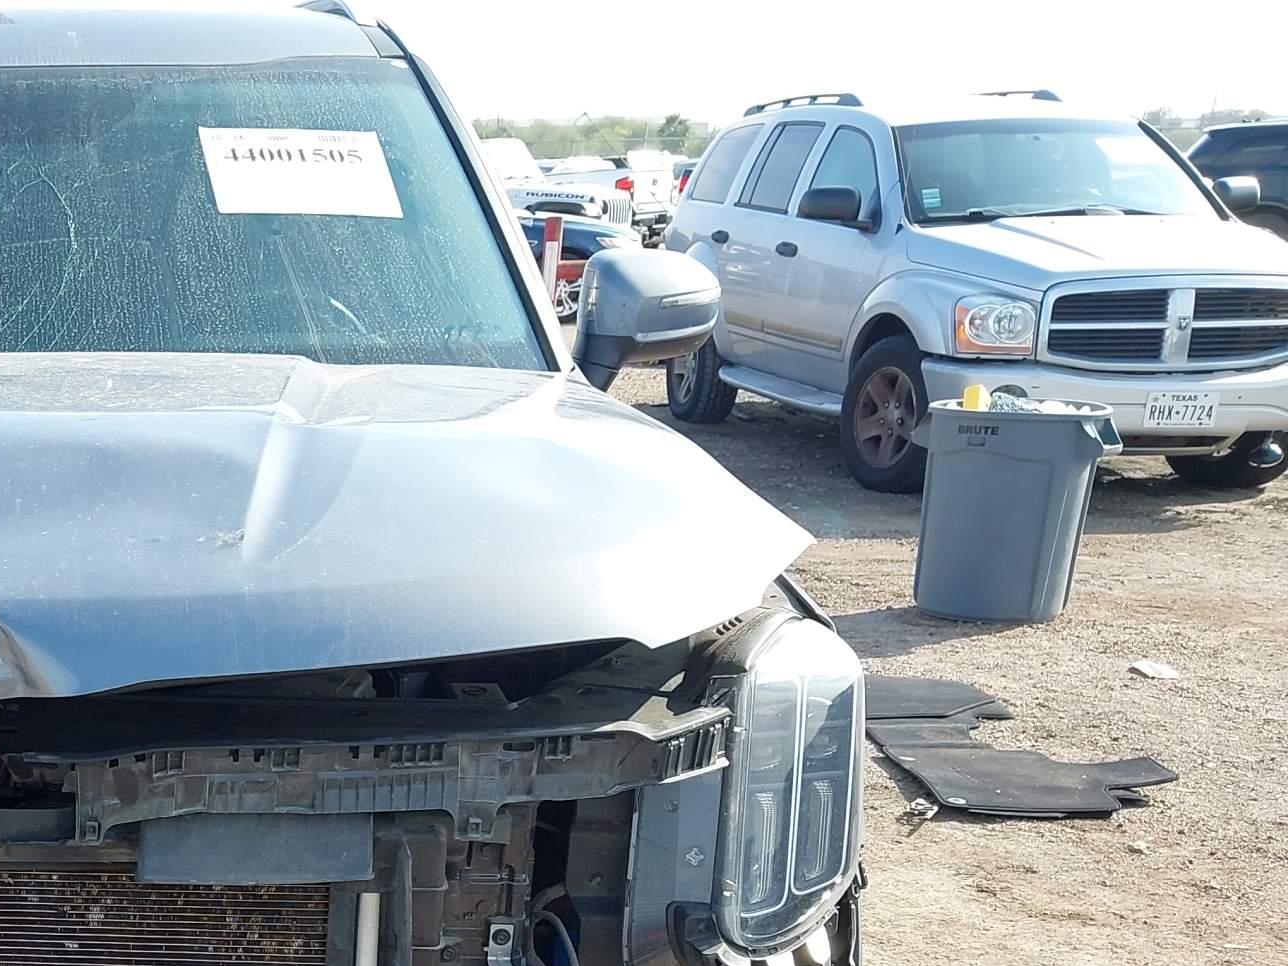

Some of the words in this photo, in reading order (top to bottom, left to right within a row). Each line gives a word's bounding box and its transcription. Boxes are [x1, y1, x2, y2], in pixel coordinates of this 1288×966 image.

[224, 147, 363, 164] 44001505
[525, 191, 585, 200] RUBICON
[1171, 394, 1198, 402] TEXAS
[958, 424, 1000, 436] BRUTE
